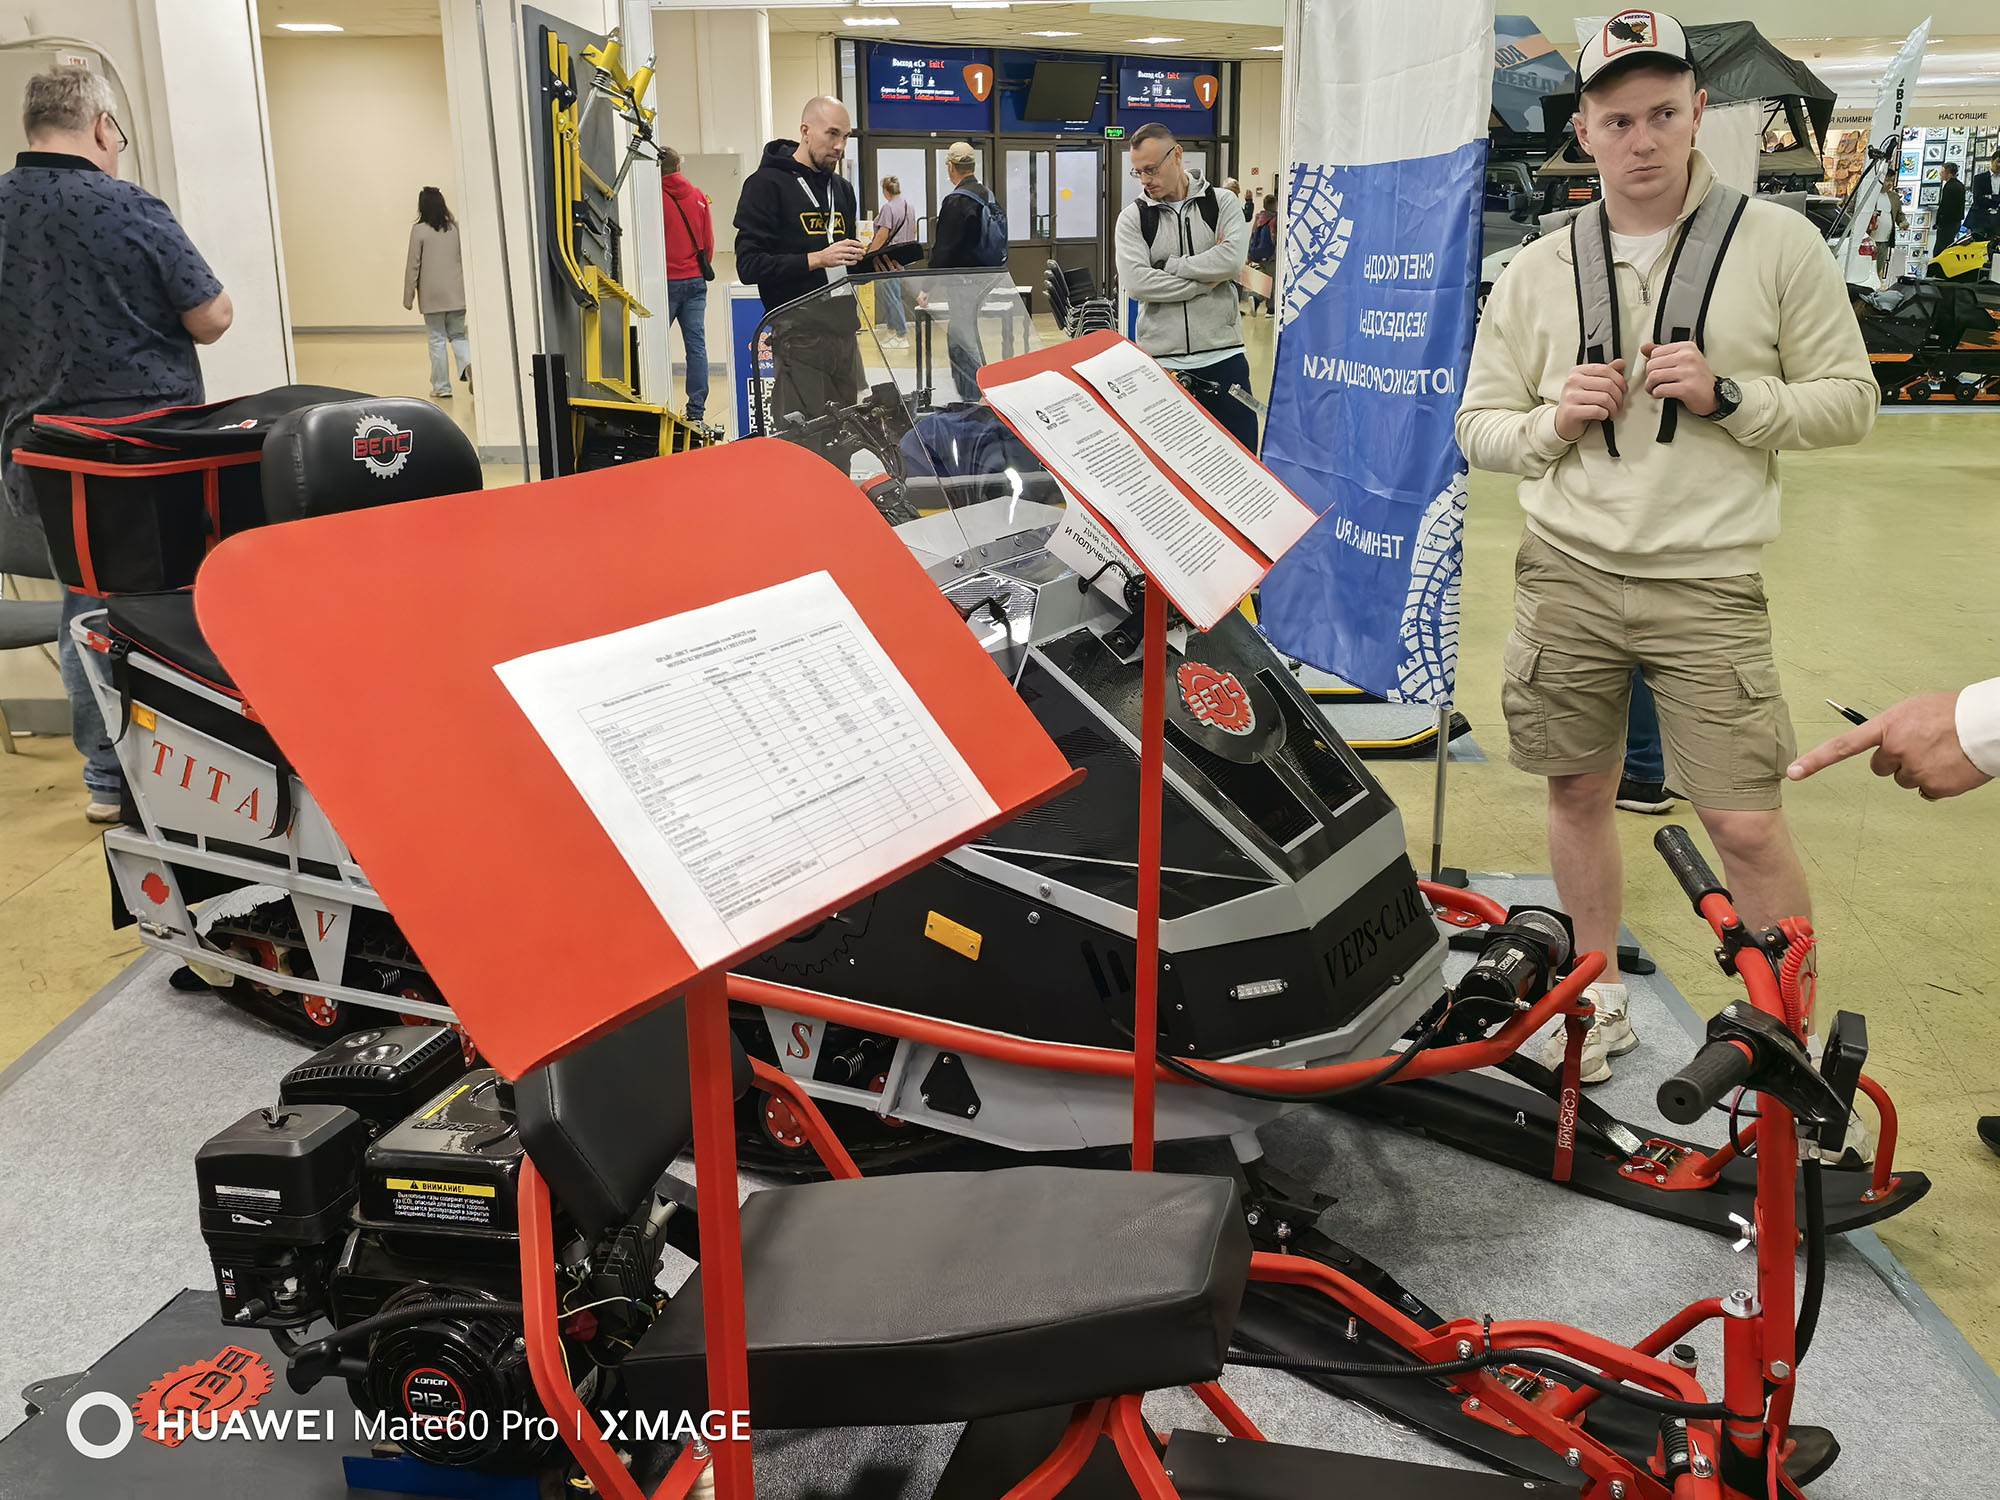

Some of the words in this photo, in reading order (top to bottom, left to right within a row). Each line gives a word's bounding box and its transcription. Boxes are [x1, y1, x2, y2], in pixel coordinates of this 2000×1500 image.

[974, 72, 983, 94] 1
[1202, 82, 1210, 102] 1
[1938, 112, 1988, 121] НАСТОЯЩИЕ
[809, 218, 842, 229] TRK
[355, 433, 410, 457] ВЕПС
[1065, 526, 1072, 536] и
[1083, 527, 1100, 544] для
[314, 909, 339, 942] V
[1323, 886, 1420, 987] VEPS-CAR
[786, 1022, 813, 1059] S
[1559, 1087, 1577, 1151] СОРОКИН
[422, 1182, 465, 1193] ВНИМАНИЕ!
